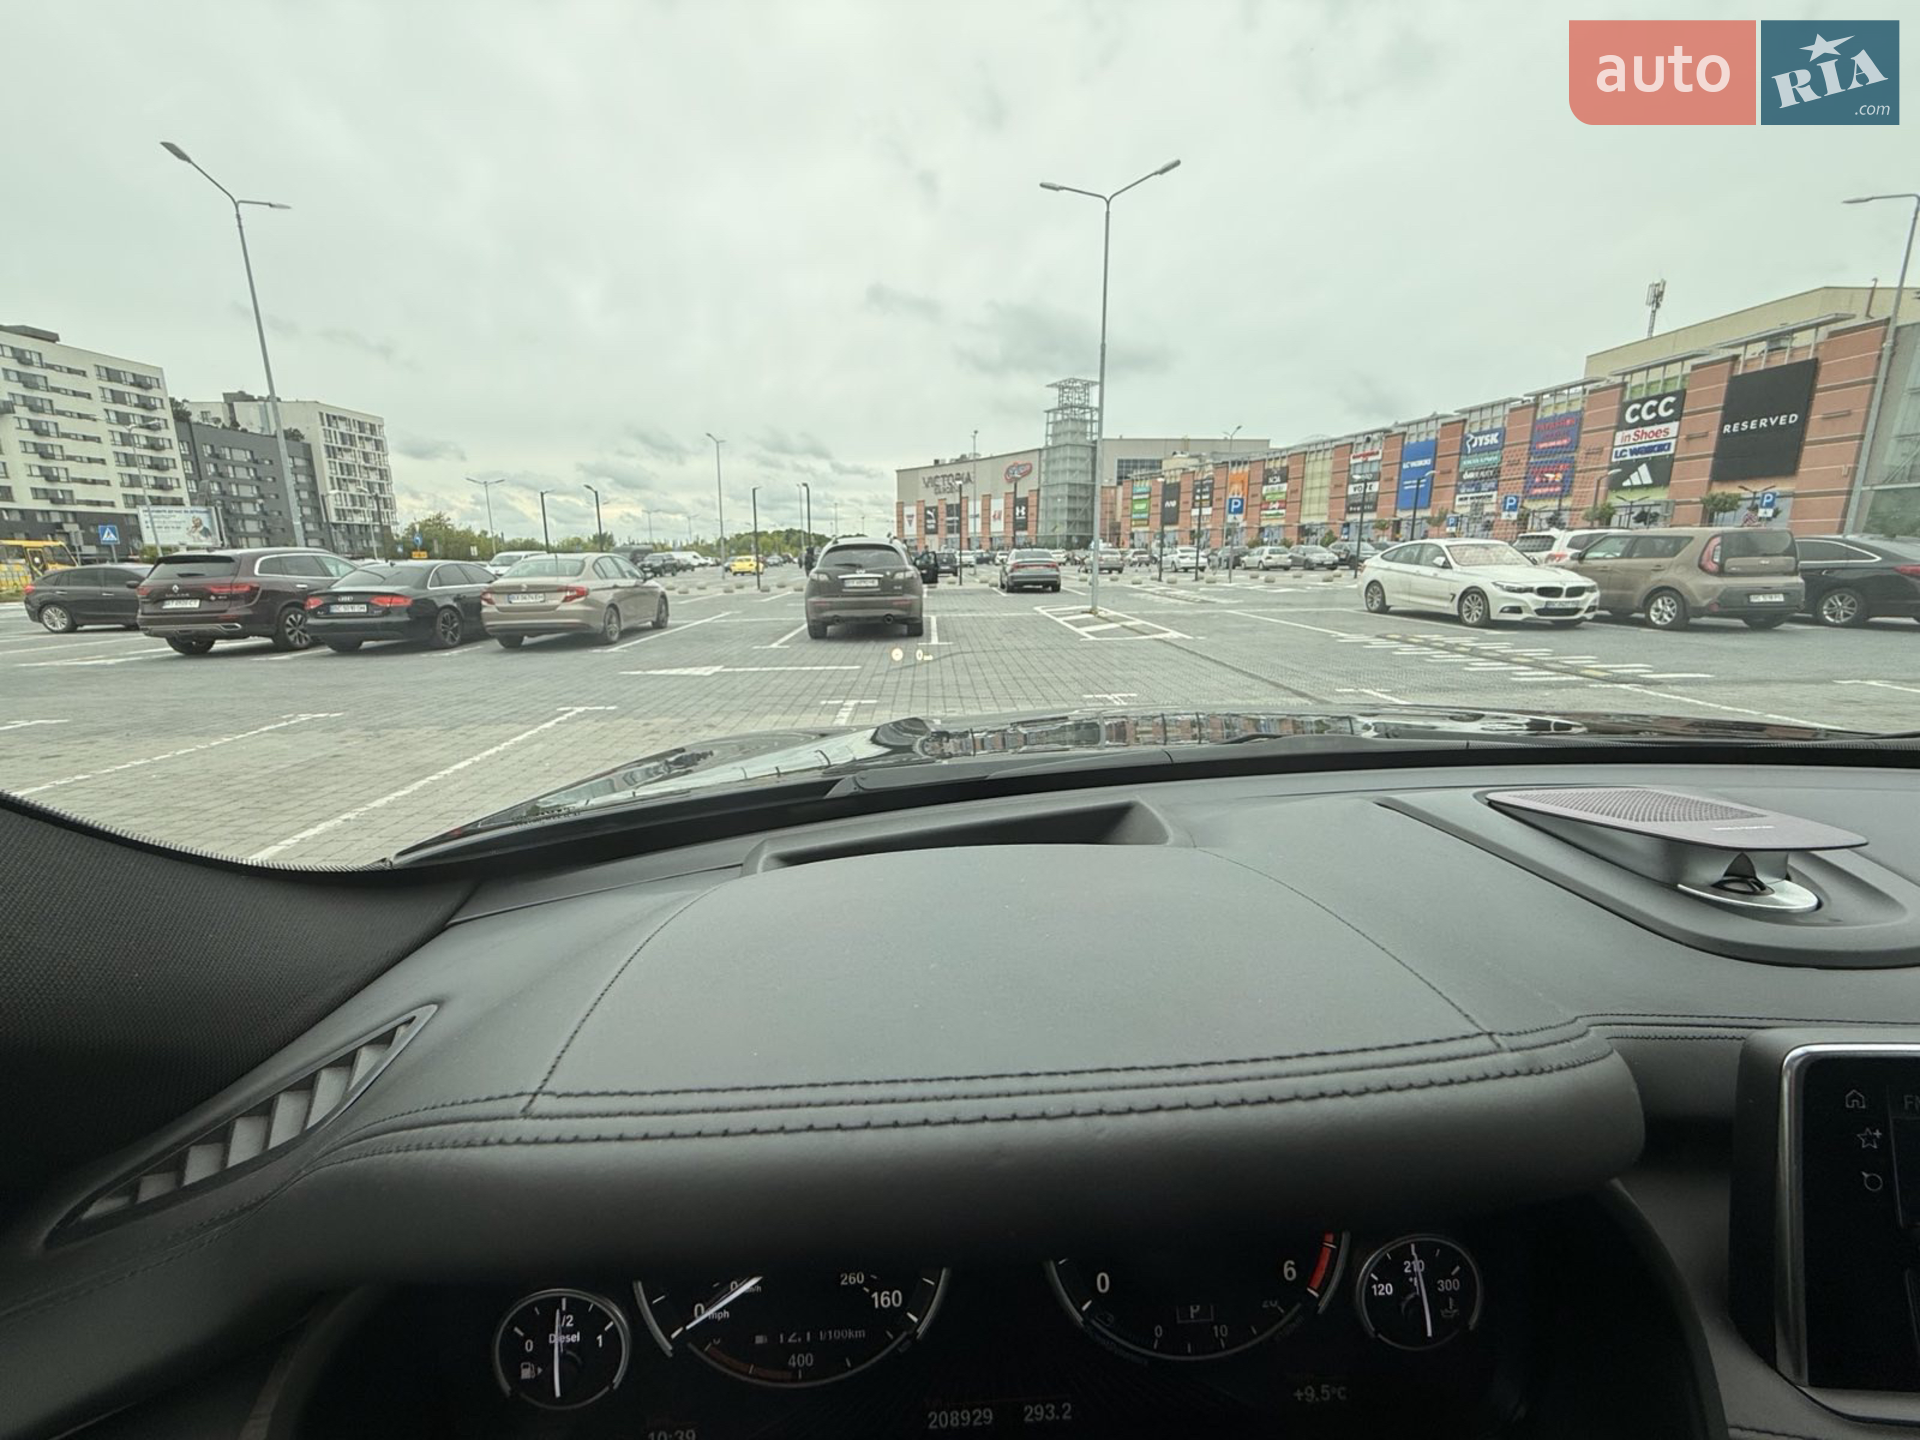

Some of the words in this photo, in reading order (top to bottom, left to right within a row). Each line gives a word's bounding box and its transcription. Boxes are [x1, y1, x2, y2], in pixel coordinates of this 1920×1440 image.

[1625, 396, 1676, 424] CCC
[1722, 413, 1799, 434] RESERVED
[1472, 432, 1500, 448] JYSK
[1620, 431, 1631, 443] in
[1632, 427, 1670, 442] Shoes
[1614, 449, 1628, 459] LC
[1230, 499, 1242, 513] P
[1506, 496, 1517, 510] P
[1763, 493, 1774, 507] P
[1282, 1260, 1297, 1281] 6
[840, 1272, 865, 1286] 260
[1095, 1271, 1111, 1294] 0
[1436, 1278, 1460, 1292] 300
[1371, 1282, 1393, 1296] 120
[871, 1289, 903, 1309] 160
[694, 1303, 705, 1320] 0
[1189, 1304, 1200, 1319] P
[548, 1331, 580, 1343] Diesel
[1153, 1324, 1163, 1338] 0
[1212, 1324, 1229, 1338] 10
[524, 1339, 534, 1353] 0
[596, 1334, 603, 1348] 1
[787, 1352, 814, 1368] 400
[927, 1407, 994, 1430] 208929
[1023, 1402, 1073, 1422] 293.2
